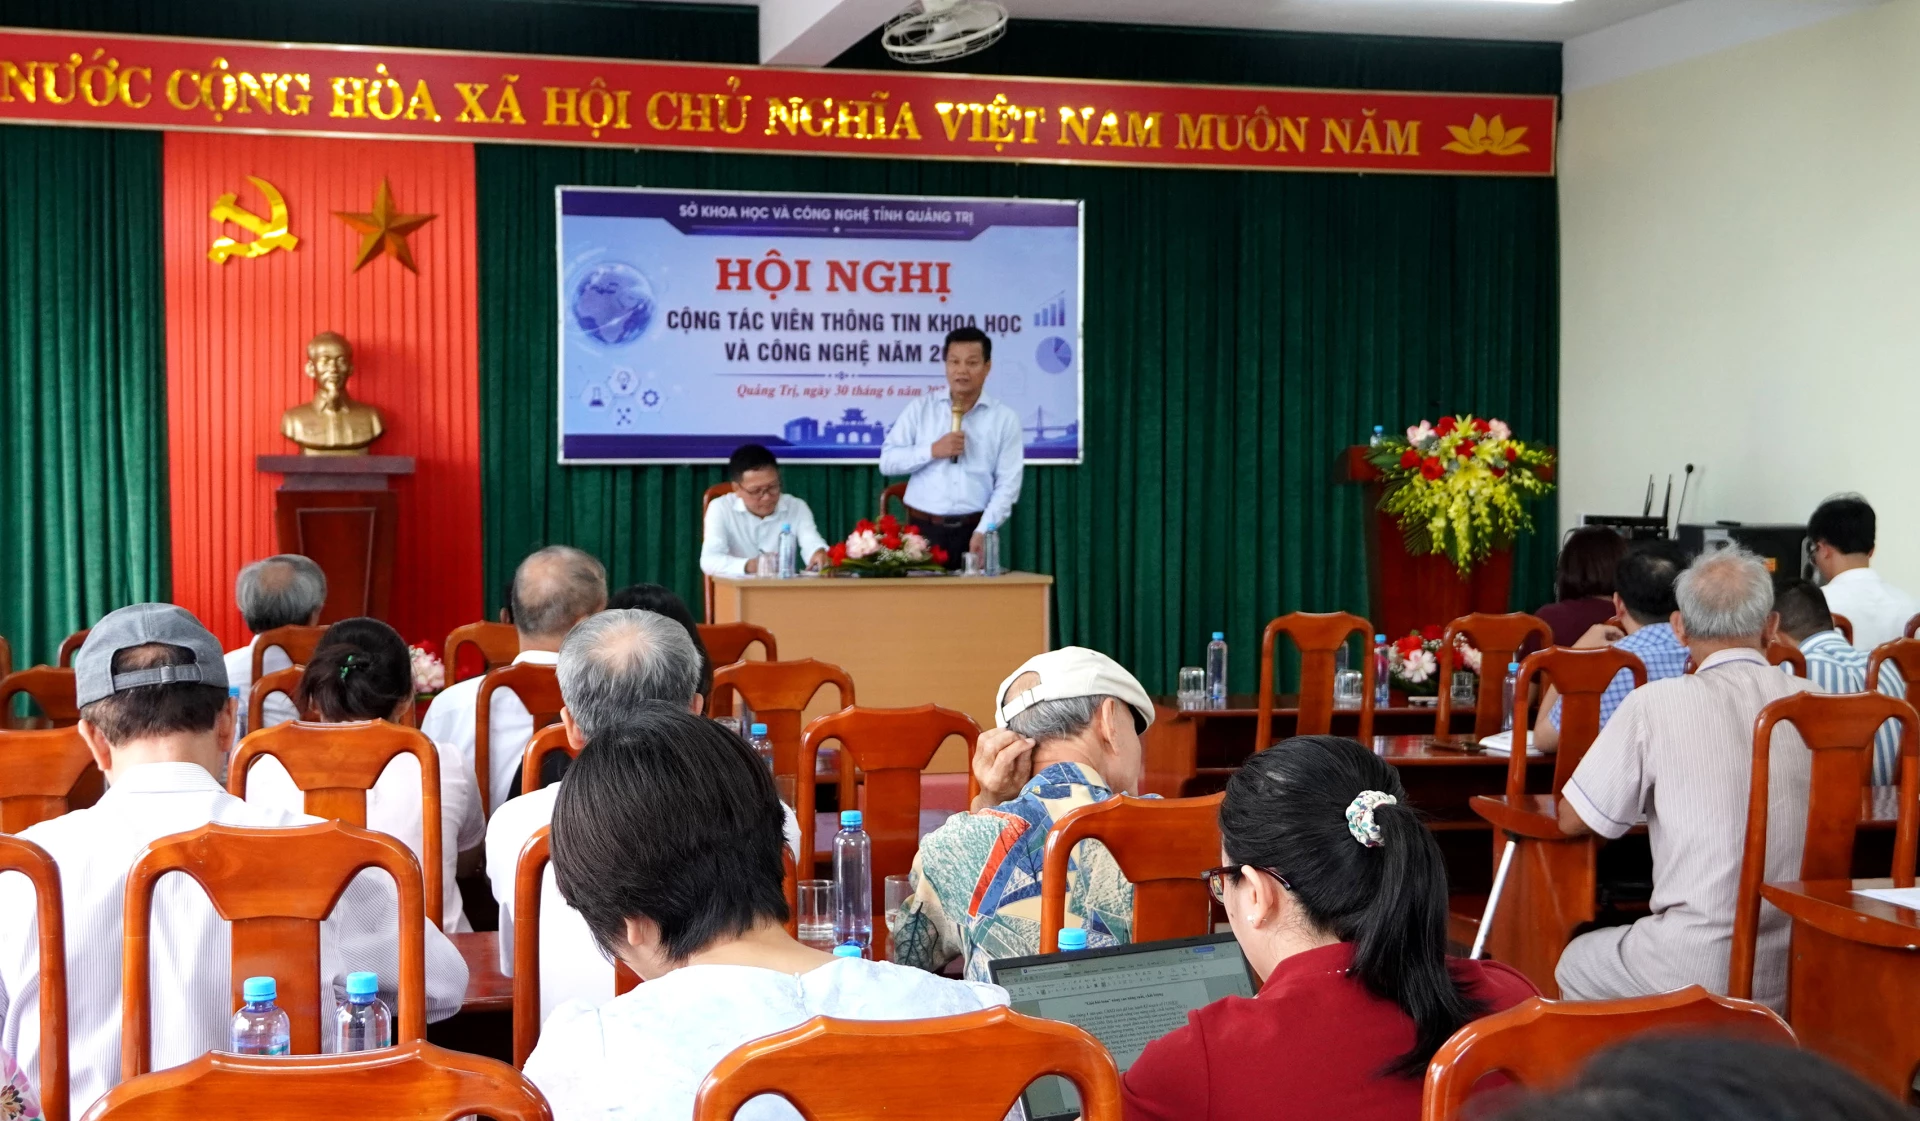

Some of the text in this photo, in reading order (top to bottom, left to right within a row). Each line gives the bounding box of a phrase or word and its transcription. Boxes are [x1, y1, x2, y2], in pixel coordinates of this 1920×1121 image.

[0, 48, 1422, 156] NƯỚC CỘNG HÒA XÃ HỘI CHỦ NGHĨA VIỆT NAM MUÔN NĂM
[679, 201, 975, 226] SỞ KHOA HỌC VÀ CÔNG NGHỆ TỈNH QUẢNG TRỊ
[716, 249, 952, 303] HỘI NGHỊ
[667, 306, 1022, 337] CỘNG TÁC VIÊN THÔNG TIN KHOA HỌC
[725, 338, 750, 361] VÀ
[757, 338, 811, 362] CÔNG
[818, 340, 870, 366] NGHỆ
[877, 340, 922, 362] NĂM
[737, 383, 776, 398] Quảng
[802, 385, 831, 398] ngày
[834, 384, 849, 396] 30
[851, 384, 884, 398] tháng
[886, 384, 895, 396] 6
[897, 384, 922, 396] năm
